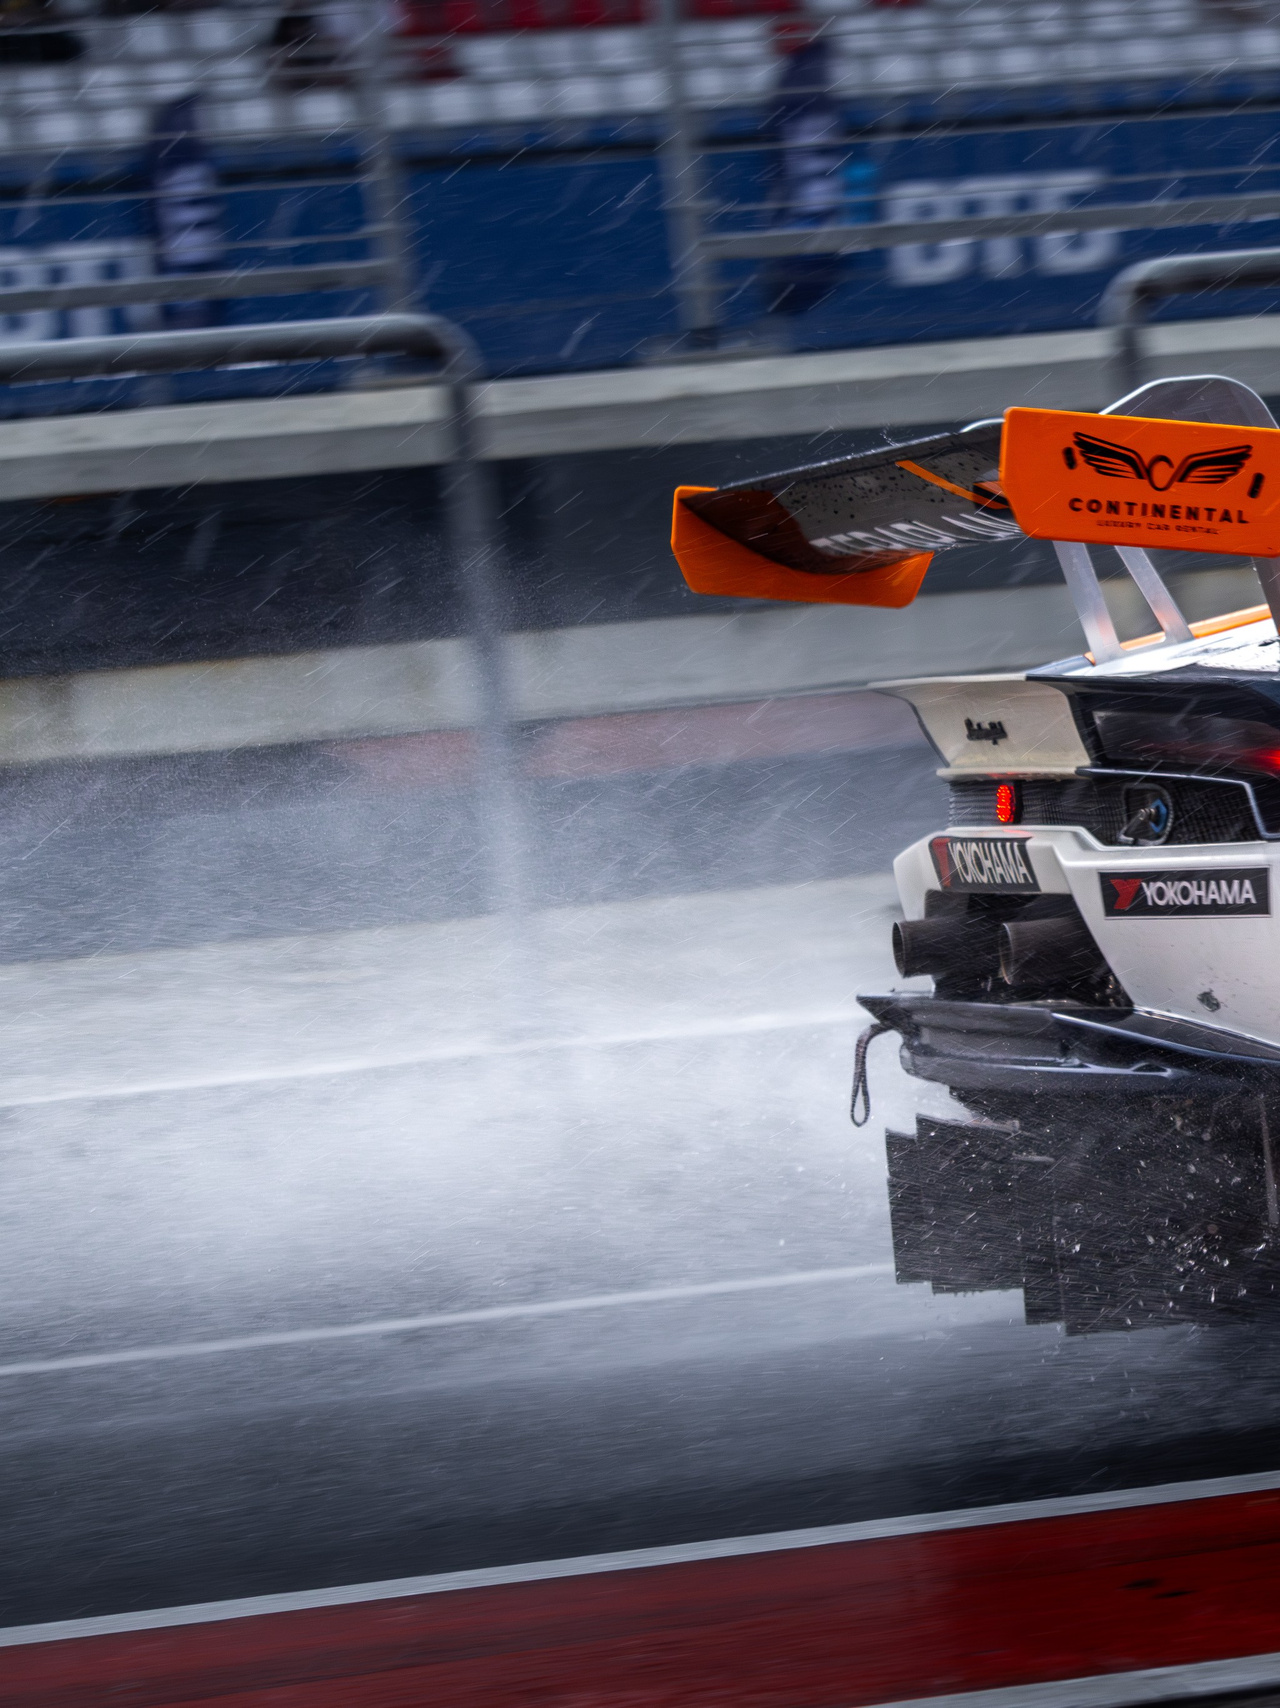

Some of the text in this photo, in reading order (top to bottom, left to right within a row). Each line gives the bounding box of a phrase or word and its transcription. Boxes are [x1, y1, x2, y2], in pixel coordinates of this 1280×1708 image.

[1069, 497, 1250, 524] CONTINENTAL
[948, 841, 1033, 884] YOKOHAMA
[1141, 879, 1257, 907] YOKOHAMA
